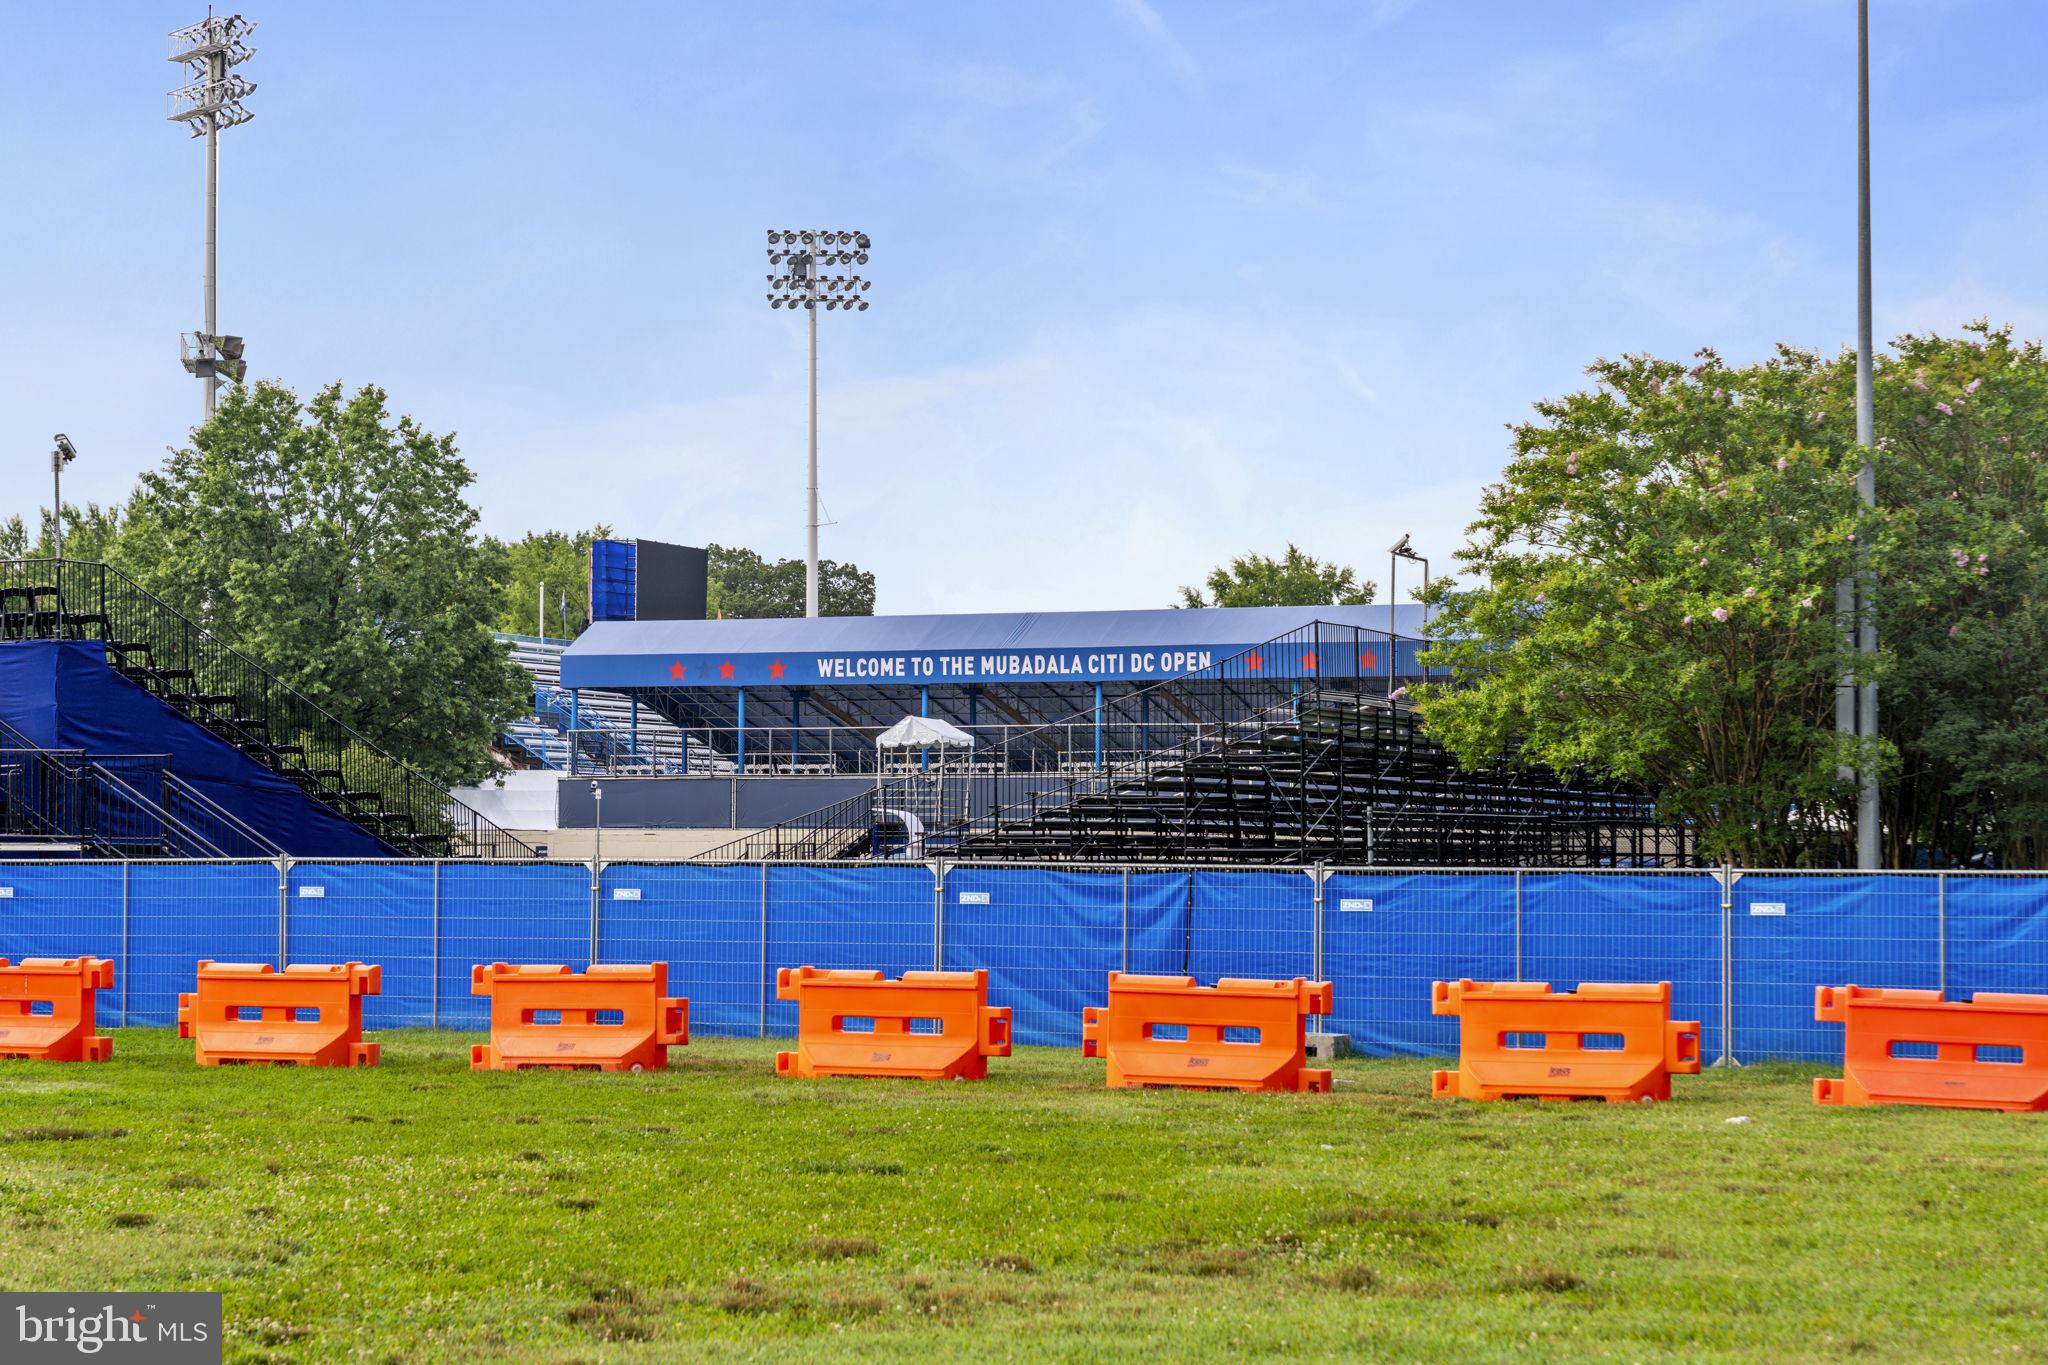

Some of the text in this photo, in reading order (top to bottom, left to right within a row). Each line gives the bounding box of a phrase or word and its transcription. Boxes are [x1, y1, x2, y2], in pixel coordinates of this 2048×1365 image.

[817, 651, 1211, 678] WELCOME TO THE MUBADALA CITI DC OPEN
